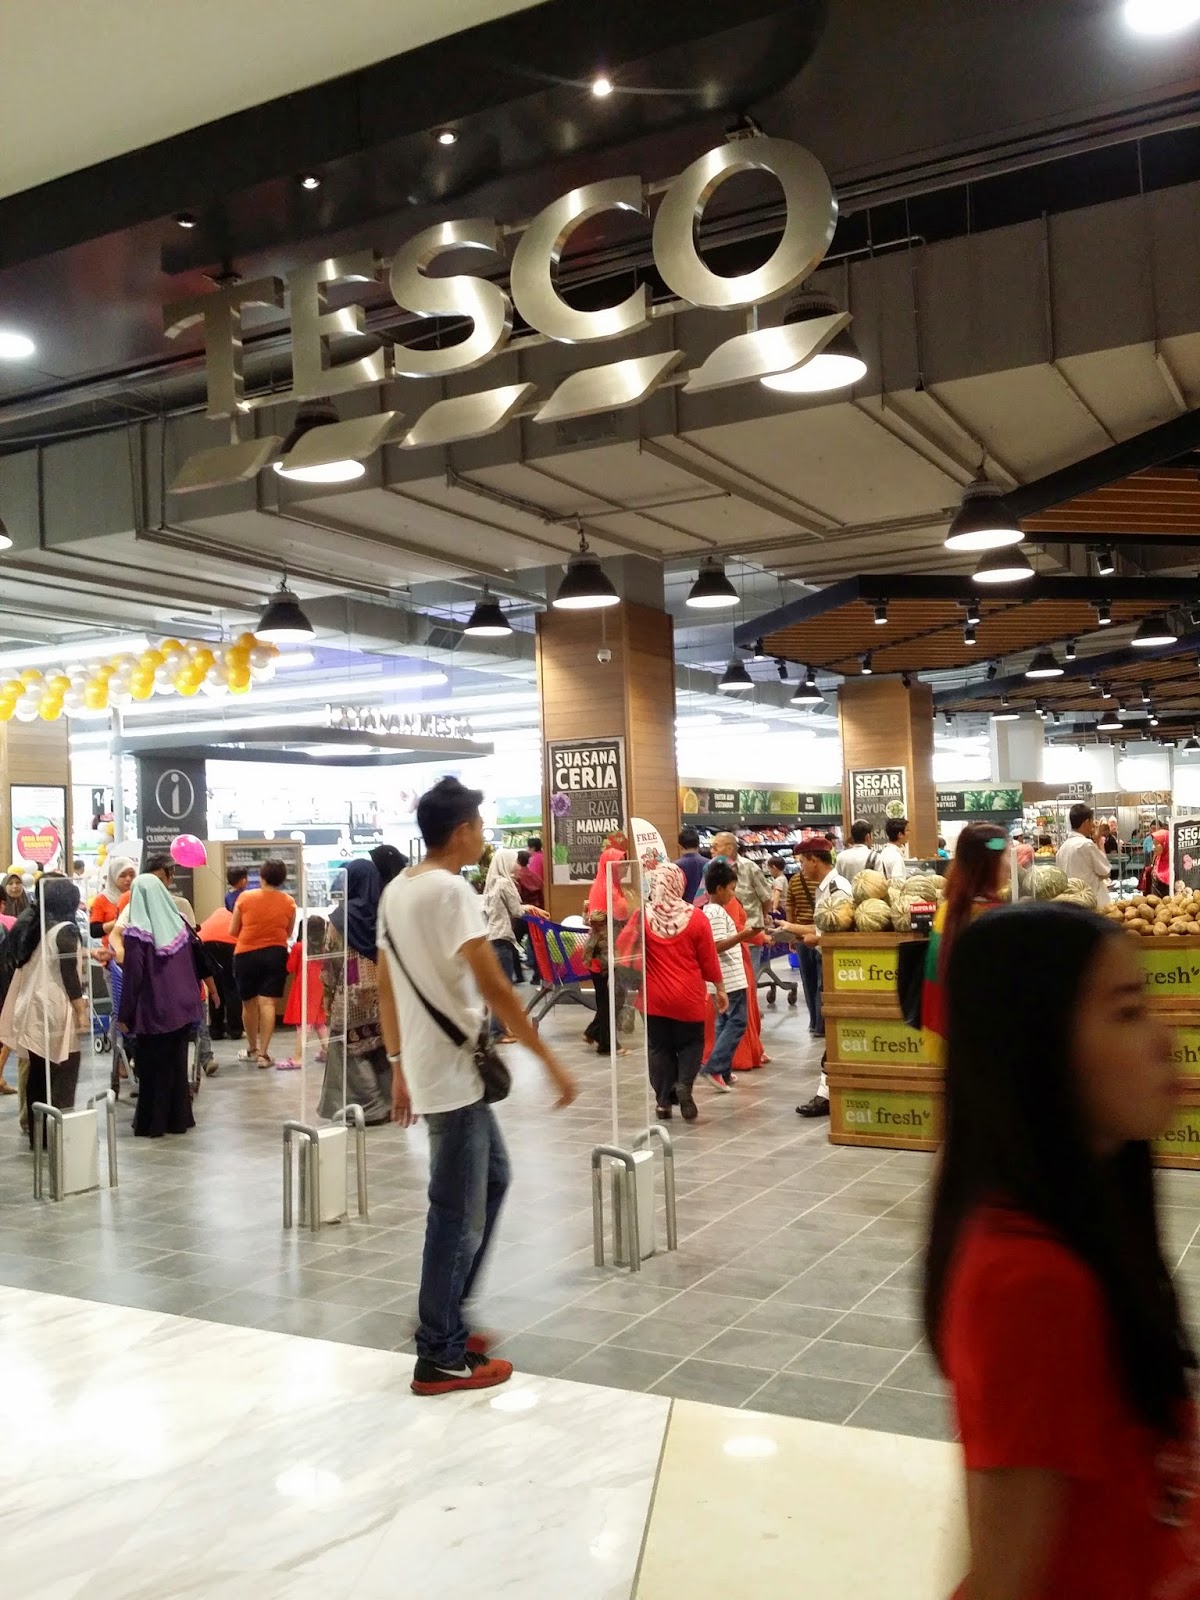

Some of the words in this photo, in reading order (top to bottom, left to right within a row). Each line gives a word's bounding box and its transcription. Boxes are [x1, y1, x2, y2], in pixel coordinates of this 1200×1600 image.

[163, 136, 838, 421] TESCO
[555, 750, 617, 768] SUASANA
[556, 765, 618, 790] CERIA
[855, 774, 901, 790] SEGAR
[856, 788, 880, 797] SETIAP
[883, 788, 901, 796] HARI
[588, 800, 620, 816] RAYA
[576, 818, 620, 833] MAWAR
[576, 834, 603, 846] ORKID
[636, 831, 658, 842] FREE
[1178, 840, 1198, 848] SETIAP
[569, 862, 598, 874] KAKT
[838, 967, 866, 982] eat
[868, 964, 899, 982] fres
[842, 1028, 866, 1036] TESCO
[842, 1038, 869, 1052] eat
[872, 1036, 919, 1053] fresh
[846, 1109, 873, 1124] eat
[876, 1107, 923, 1126] fresh
